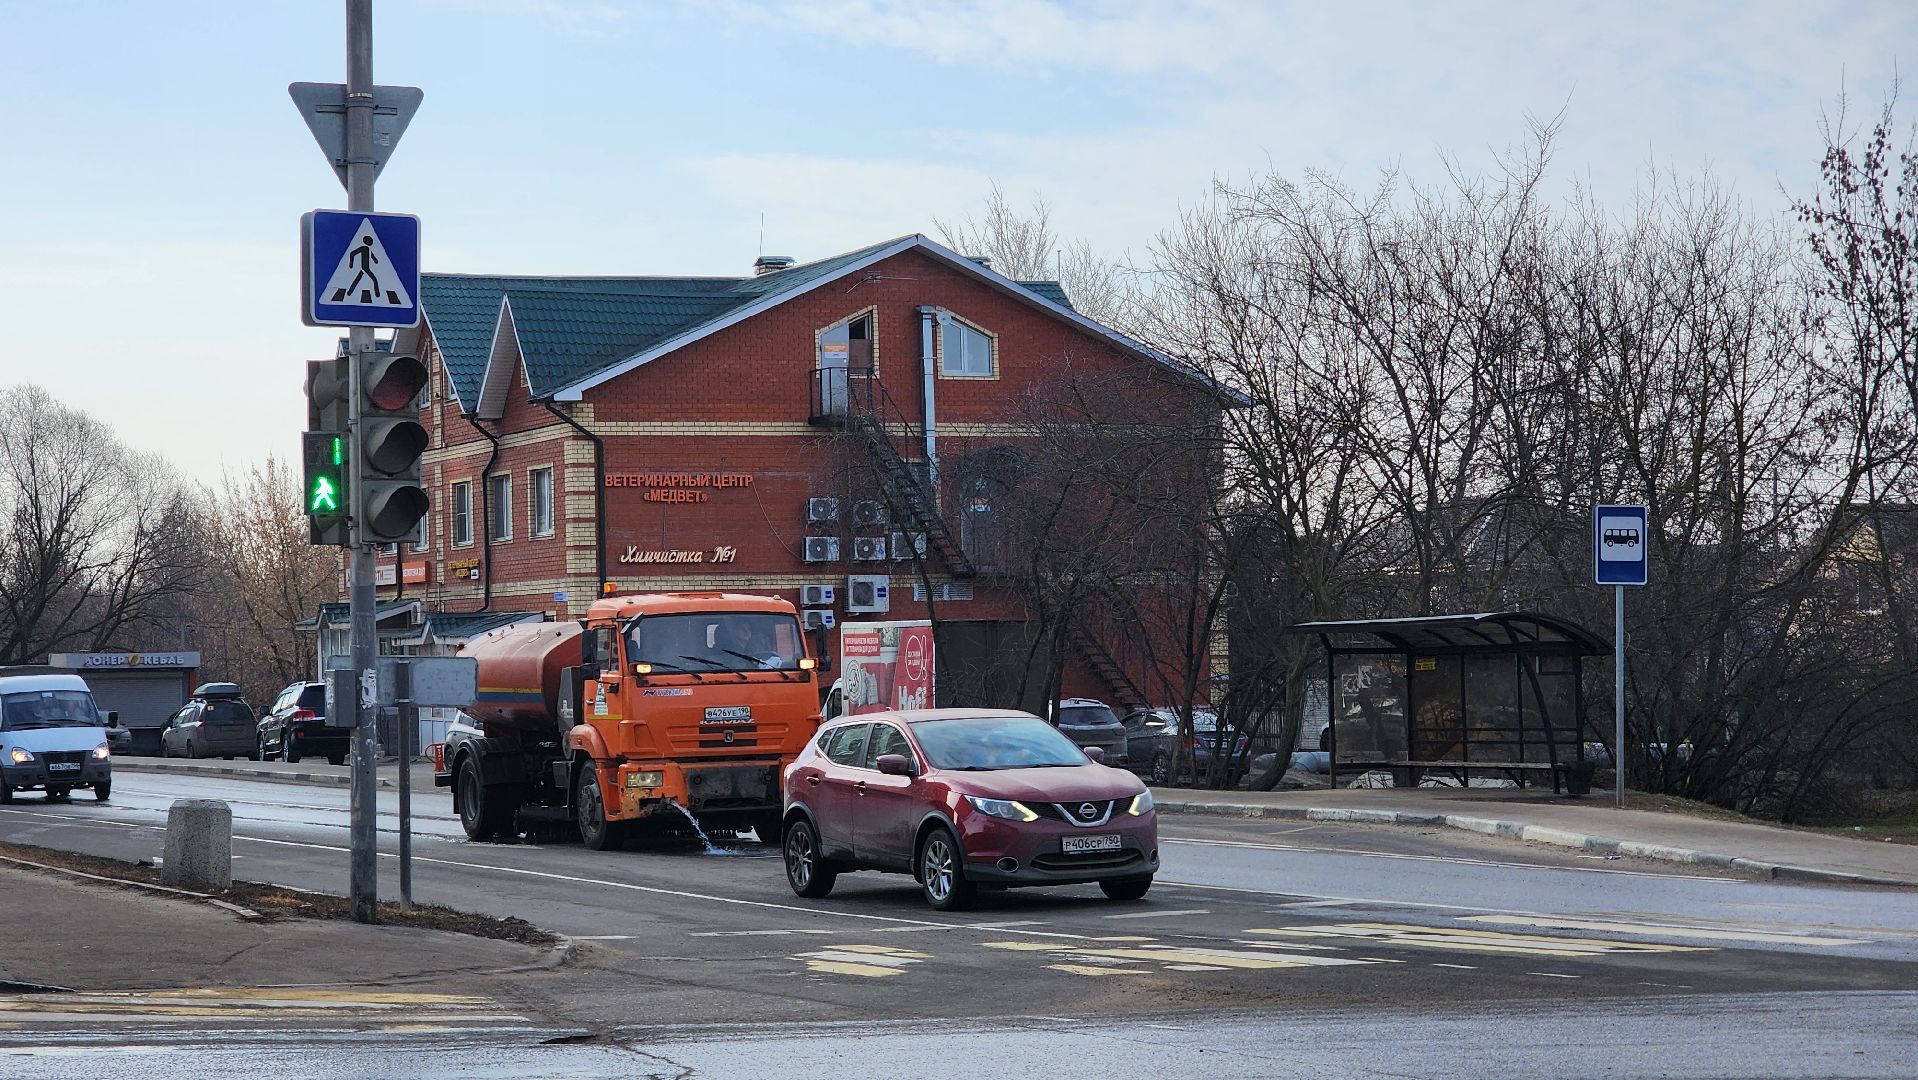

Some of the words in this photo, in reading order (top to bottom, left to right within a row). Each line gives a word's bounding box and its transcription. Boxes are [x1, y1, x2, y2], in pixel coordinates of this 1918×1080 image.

[604, 473, 709, 487] ВЕТЕРИНАРНЫЙ
[712, 473, 753, 489] ЦЕНТР
[643, 489, 708, 504] «МЕДВЕТ»
[620, 545, 703, 563] Химчистка
[711, 546, 737, 563] №1
[144, 655, 184, 665] КЕБАБ
[1065, 837, 1102, 850] Р406СР
[1105, 835, 1118, 845] 750
